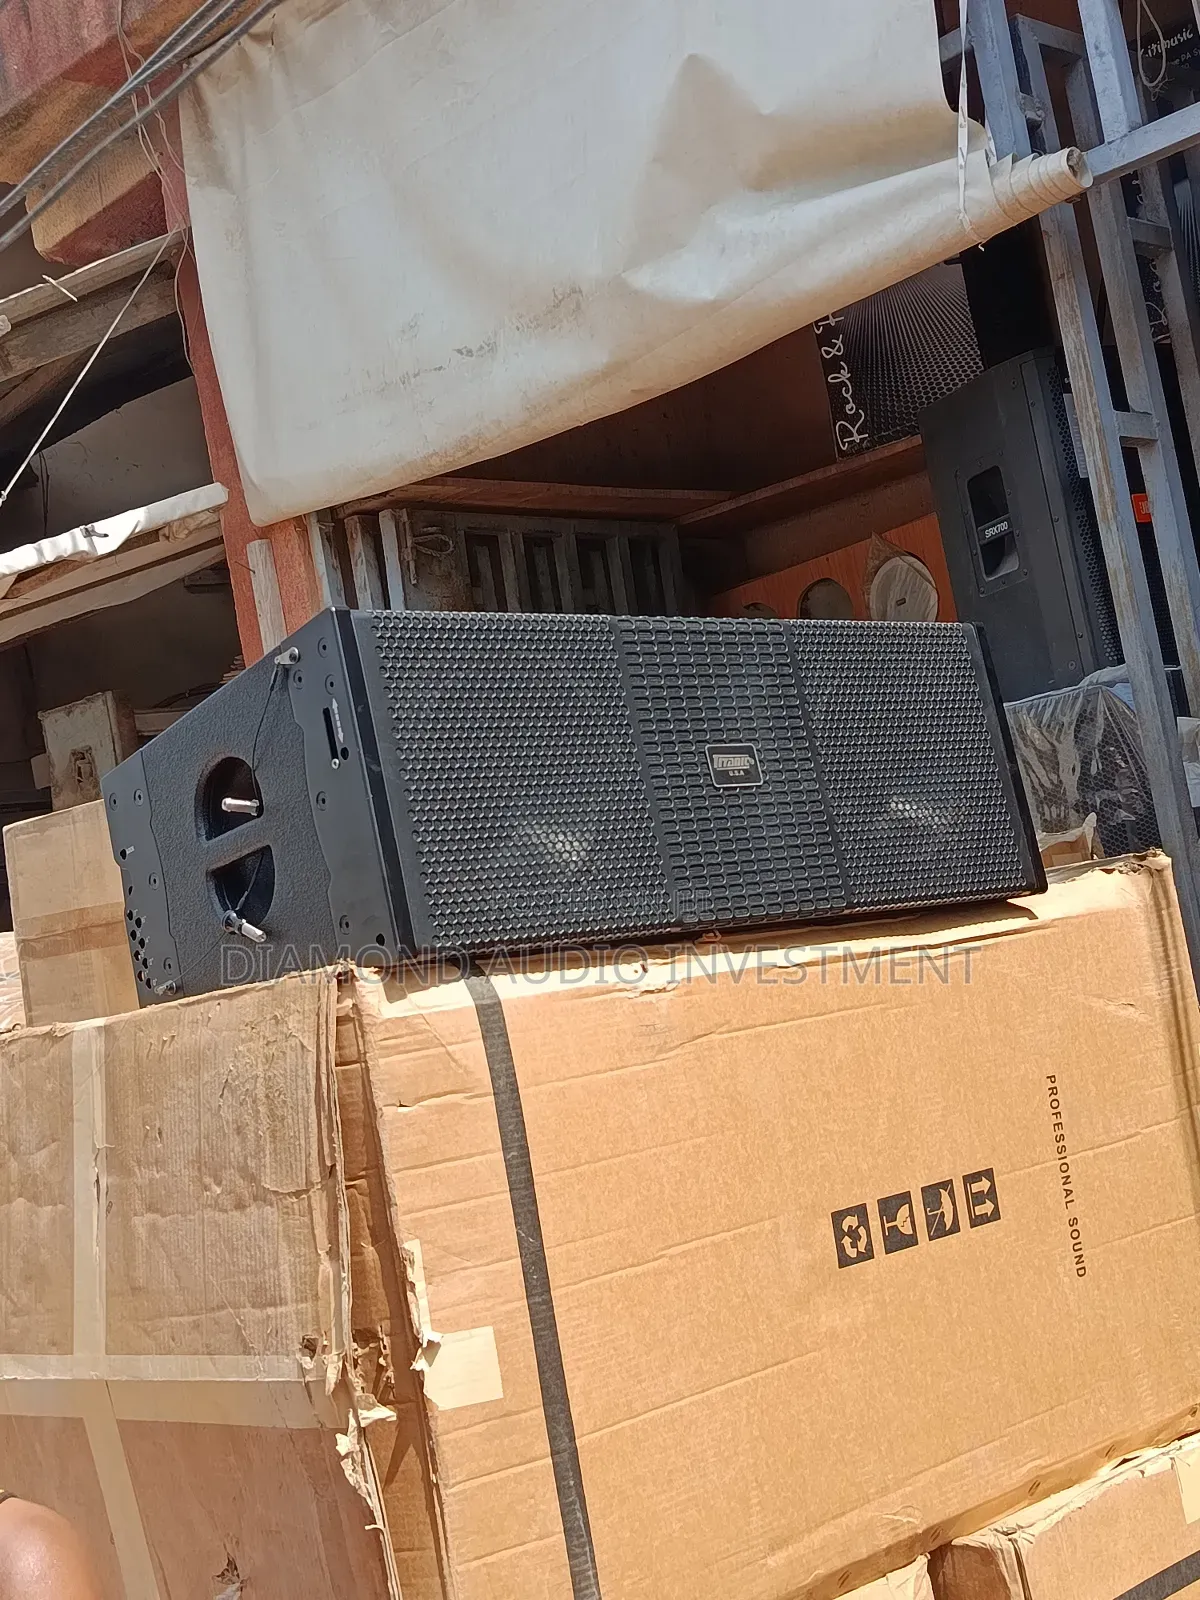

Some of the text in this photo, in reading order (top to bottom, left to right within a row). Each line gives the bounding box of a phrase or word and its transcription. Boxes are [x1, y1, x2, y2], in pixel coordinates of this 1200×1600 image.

[821, 334, 844, 359] &
[828, 361, 869, 451] Rock
[984, 521, 1009, 539] SRX700
[1046, 1074, 1087, 1278] PROFESSIONAL SOUND
